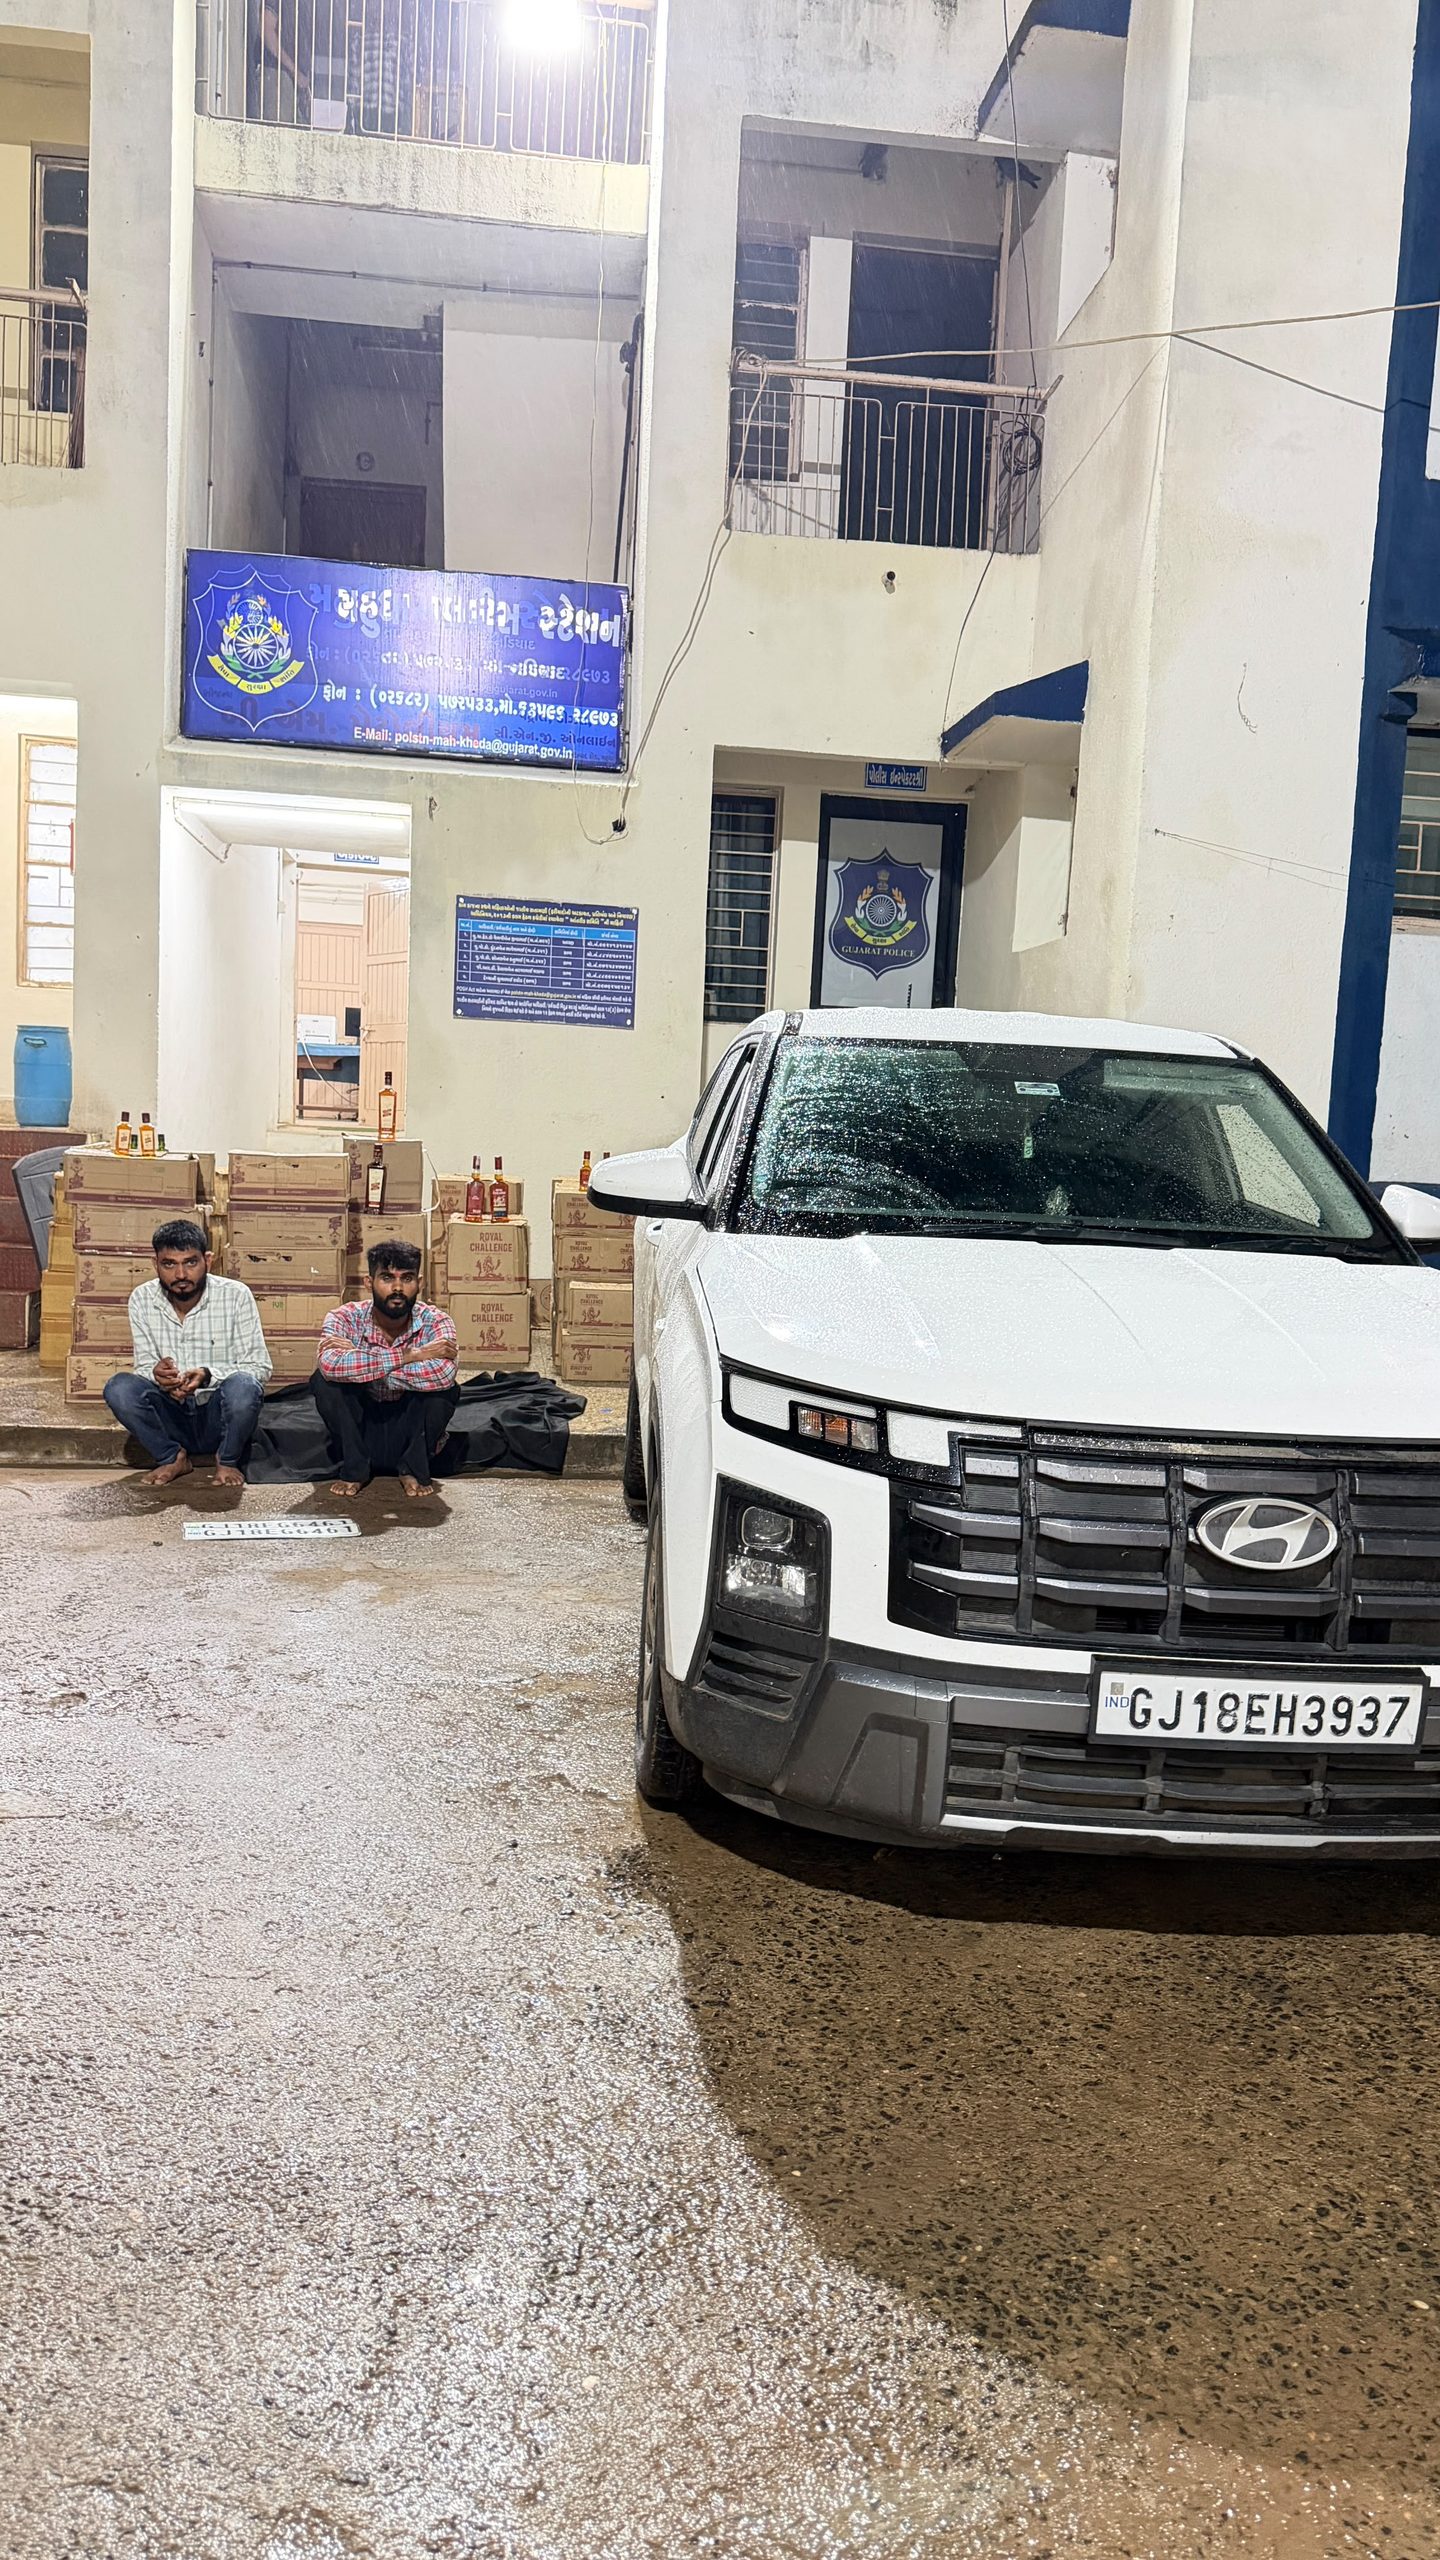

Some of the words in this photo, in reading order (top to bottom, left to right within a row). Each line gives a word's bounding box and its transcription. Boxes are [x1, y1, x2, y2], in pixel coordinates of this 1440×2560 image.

[323, 678, 347, 702] ફોન
[354, 727, 392, 741] E-Mail:
[395, 732, 573, 759] polstn-mah-kheda@gujarat.gov.in
[841, 945, 881, 955] GUJARAT
[883, 948, 916, 958] POLICE
[480, 1232, 503, 1242] ROYAL
[470, 1243, 512, 1252] CHALLENGE
[481, 1304, 504, 1313] ROYAL
[471, 1314, 514, 1322] CHALLENGE
[1105, 1696, 1129, 1708] IND
[1129, 1687, 1410, 1737] GJ18EH3937
